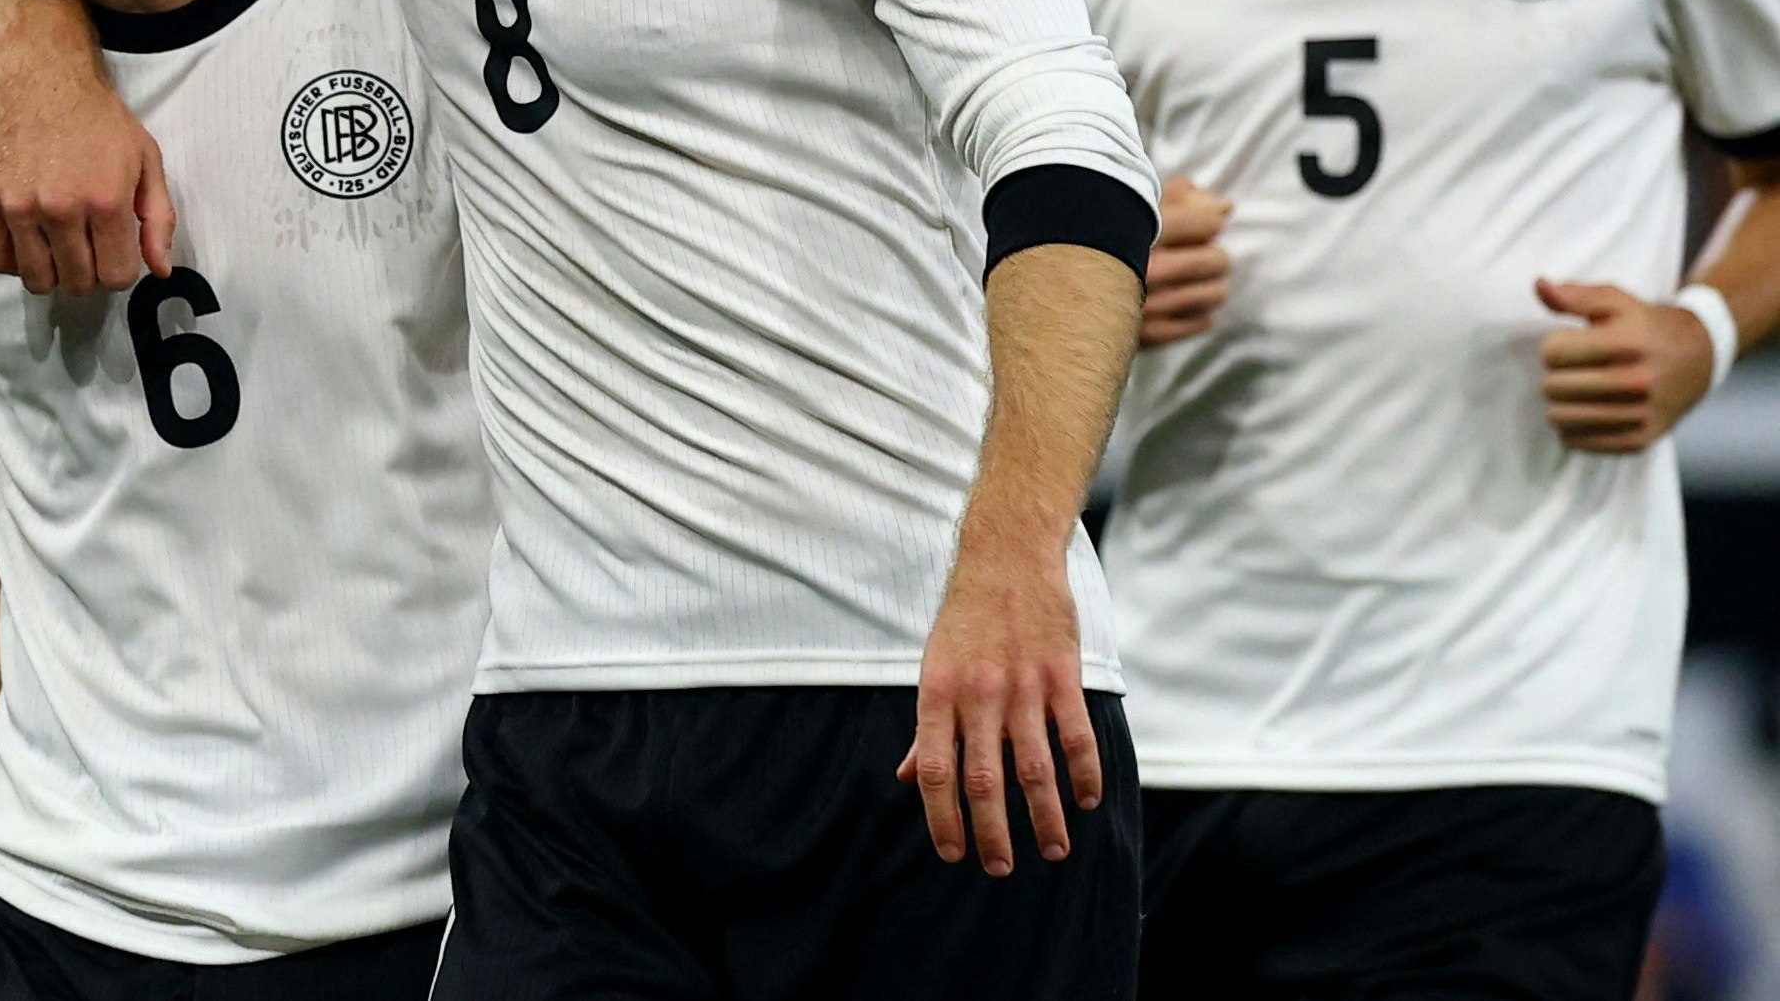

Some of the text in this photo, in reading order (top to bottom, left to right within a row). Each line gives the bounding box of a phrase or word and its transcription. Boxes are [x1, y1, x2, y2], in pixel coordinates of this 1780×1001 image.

[288, 76, 407, 184] DEUTSCHER FUSSBALL-BUND
[336, 178, 366, 193] 125
[1298, 37, 1383, 199] 5
[126, 266, 241, 449] 6
